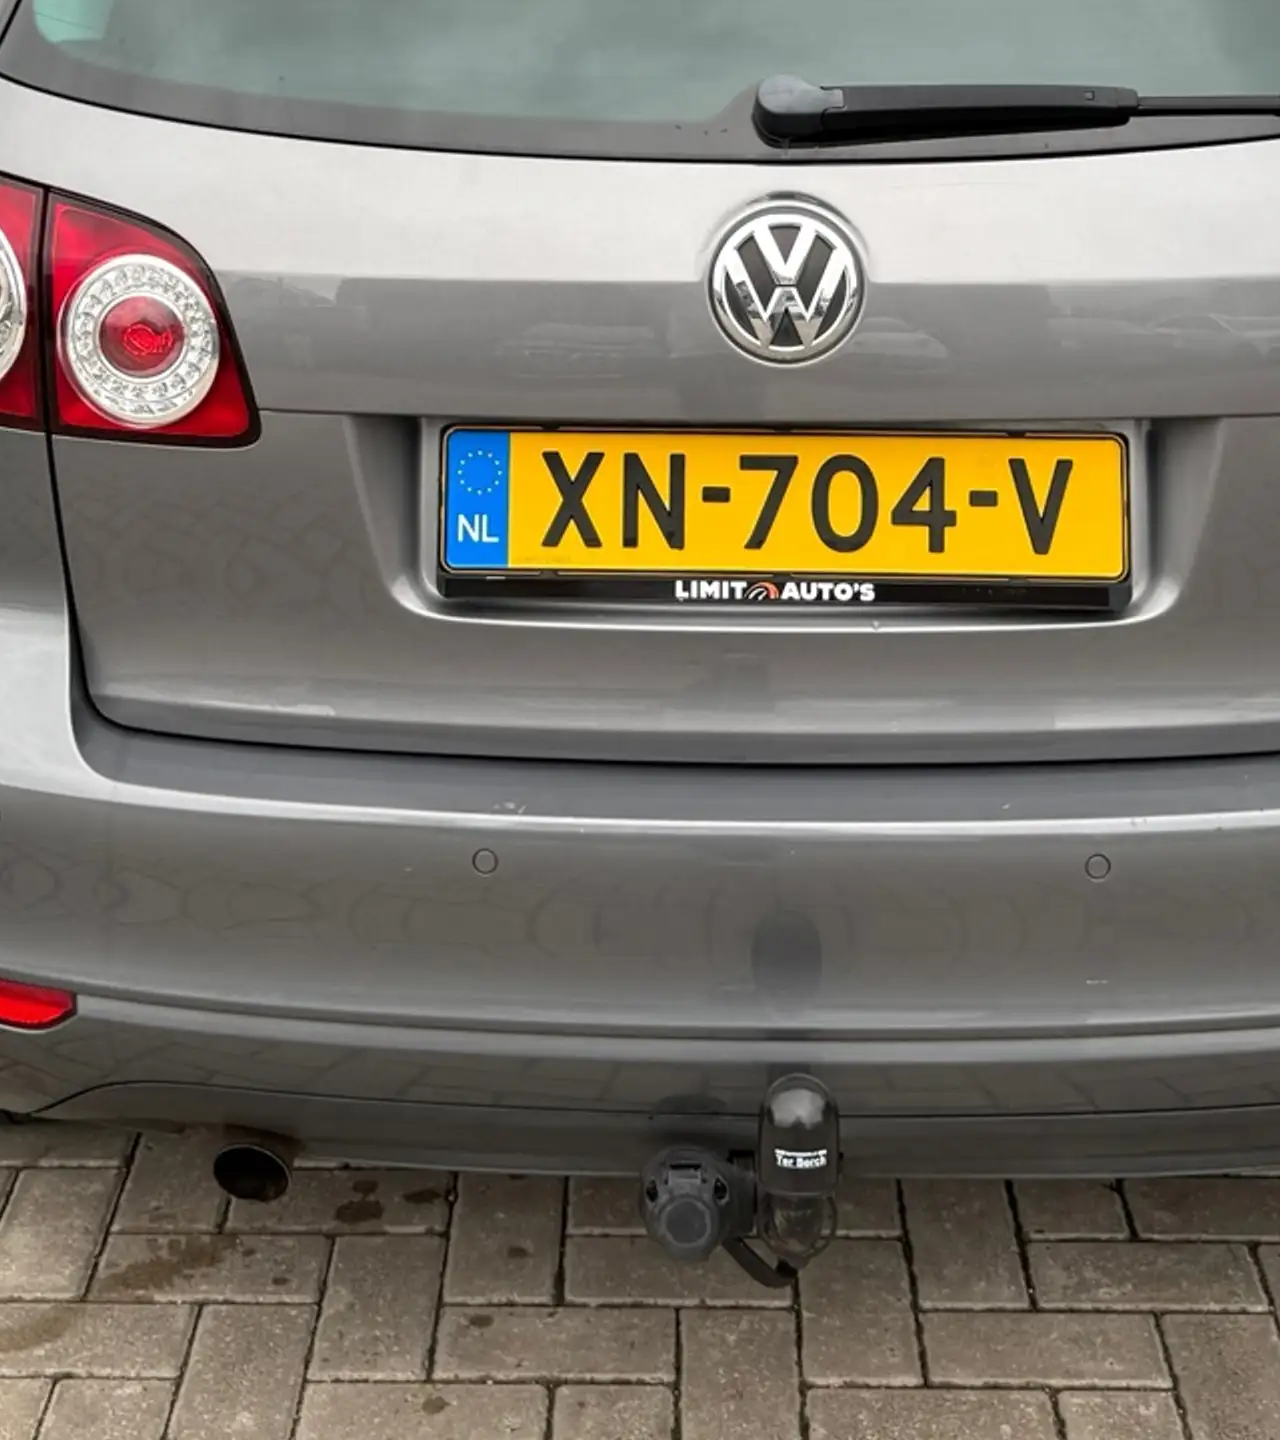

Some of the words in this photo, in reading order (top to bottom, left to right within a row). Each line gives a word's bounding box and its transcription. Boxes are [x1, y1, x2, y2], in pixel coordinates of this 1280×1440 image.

[458, 513, 500, 543] NL
[541, 451, 1073, 555] XN-704-V
[675, 580, 747, 600] LIMIT
[780, 581, 876, 602] AUTO'S
